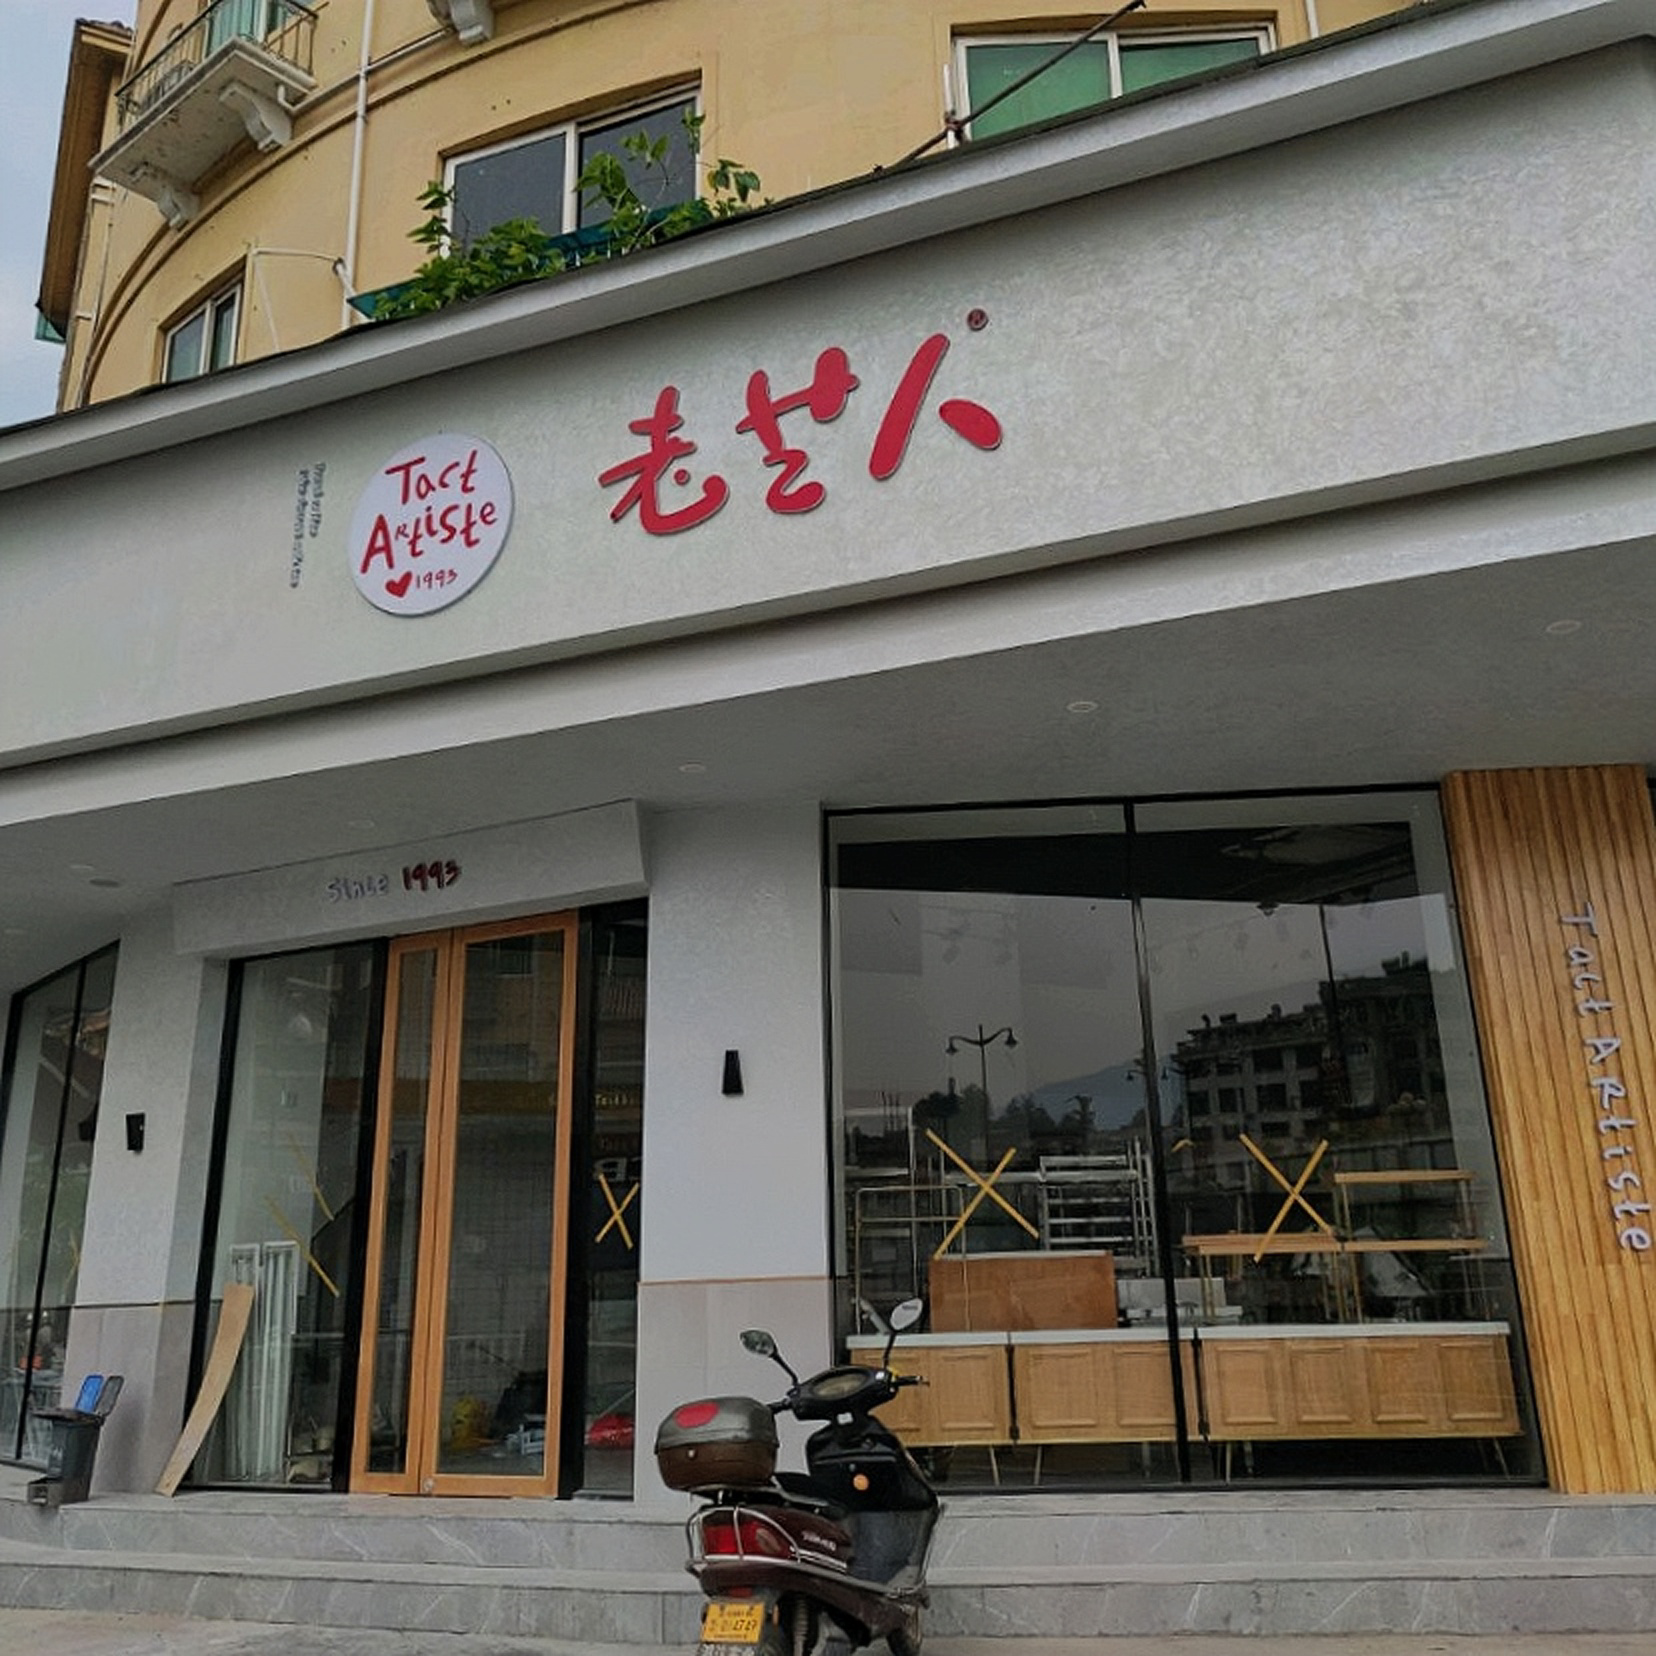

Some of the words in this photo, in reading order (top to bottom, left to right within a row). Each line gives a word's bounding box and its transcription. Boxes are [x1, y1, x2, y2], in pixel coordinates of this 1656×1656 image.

[598, 333, 1003, 536] 老艺人
[385, 450, 478, 505] Tact
[416, 568, 458, 589] 1993
[402, 859, 461, 892] 1993
[1561, 902, 1613, 1017] Tact
